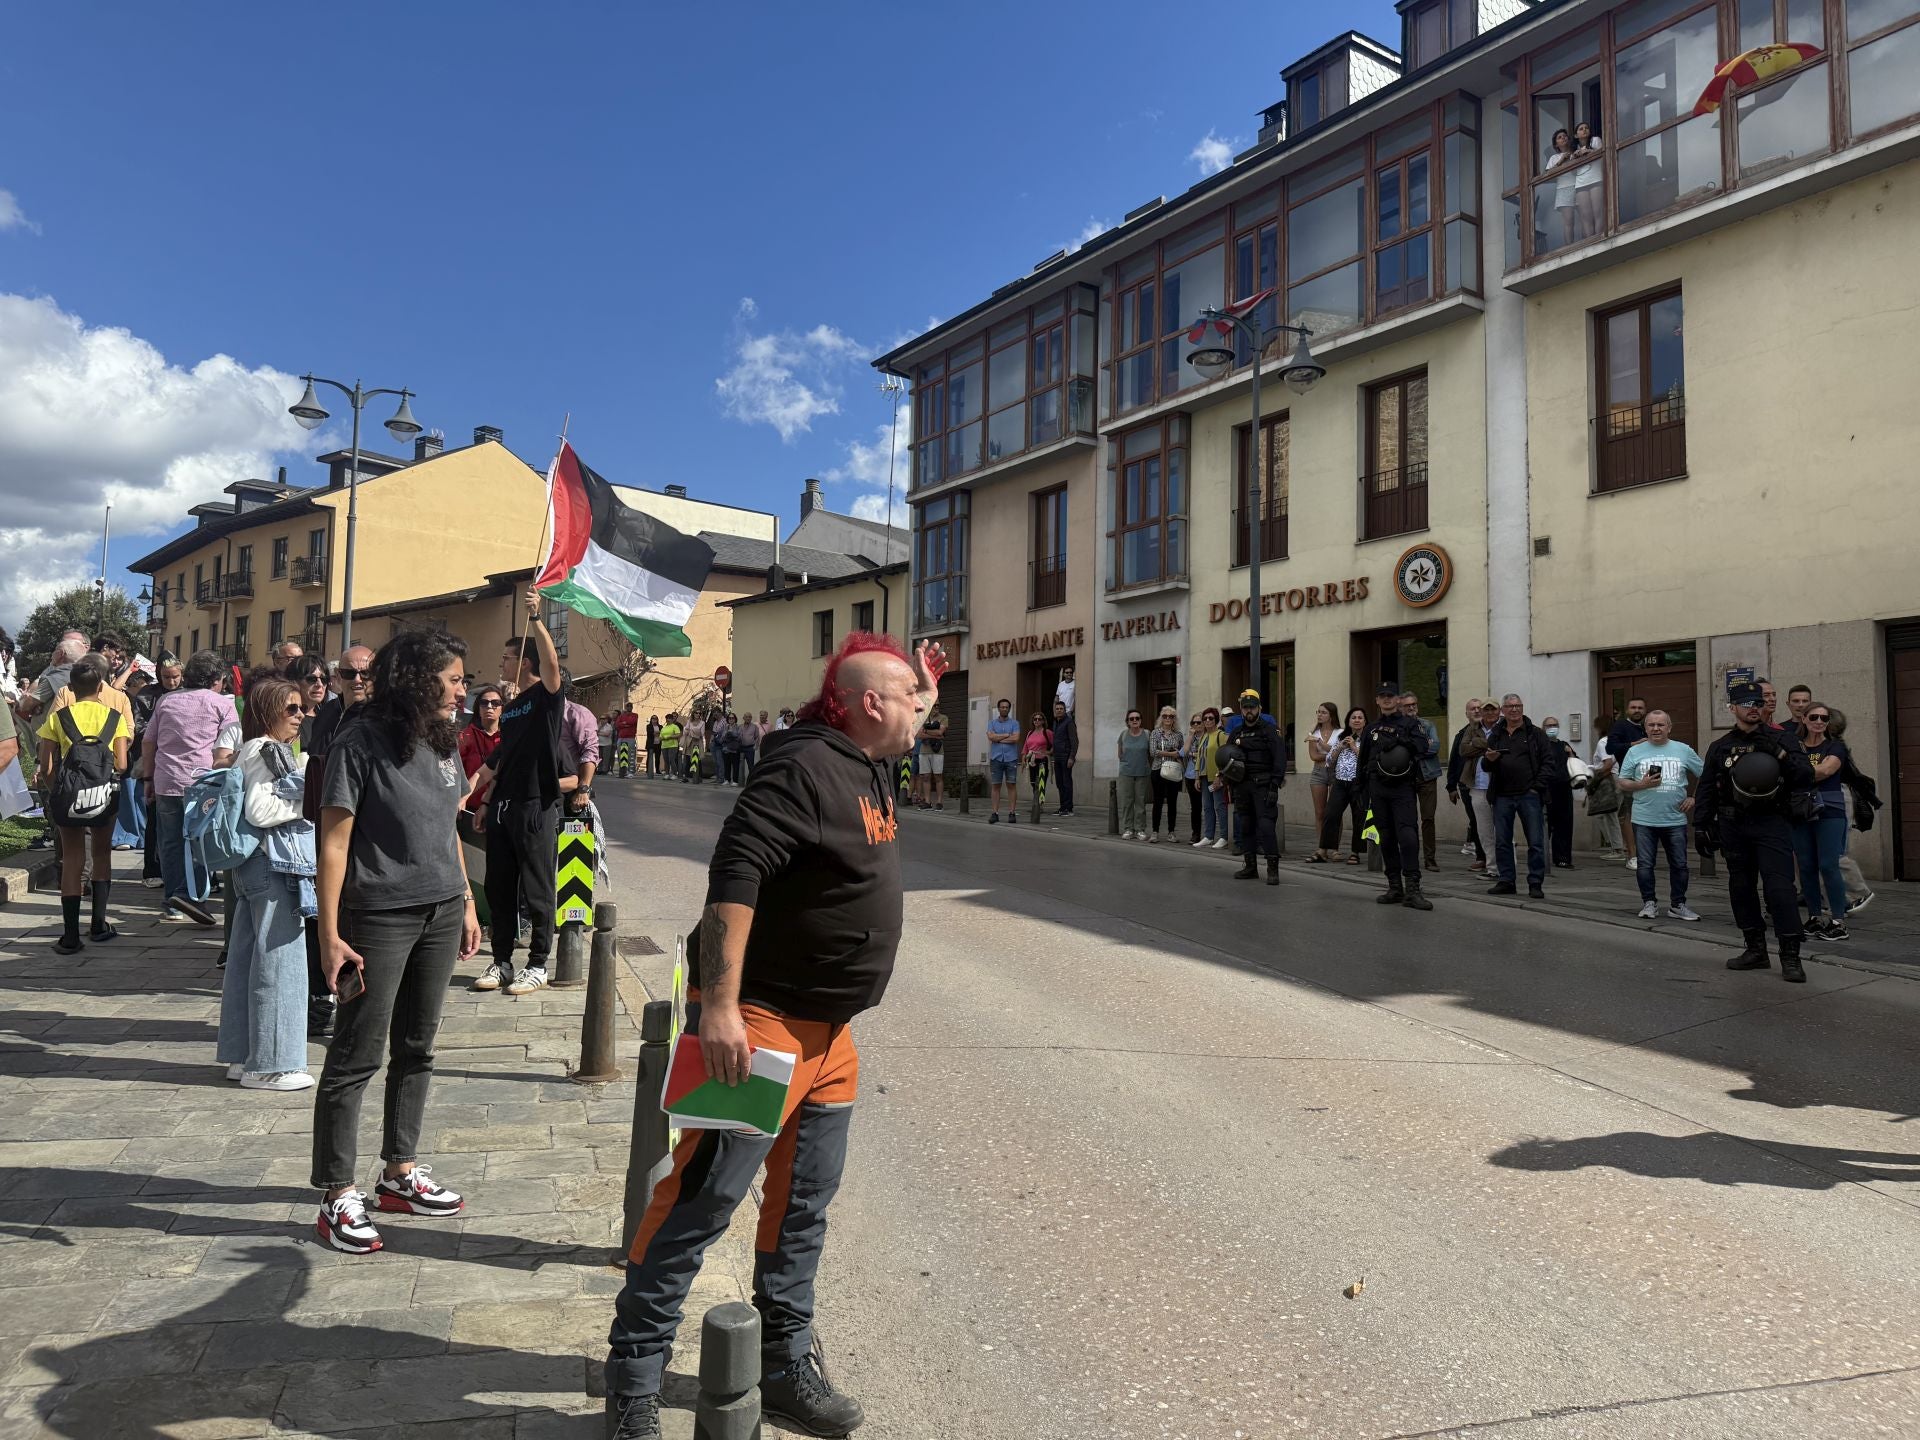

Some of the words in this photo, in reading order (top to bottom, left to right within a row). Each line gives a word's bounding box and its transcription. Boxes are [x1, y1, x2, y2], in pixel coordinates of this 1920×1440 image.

[1101, 611, 1181, 641] TAPERIA
[976, 627, 1084, 660] RESTAURANTE
[1644, 655, 1657, 665] 145
